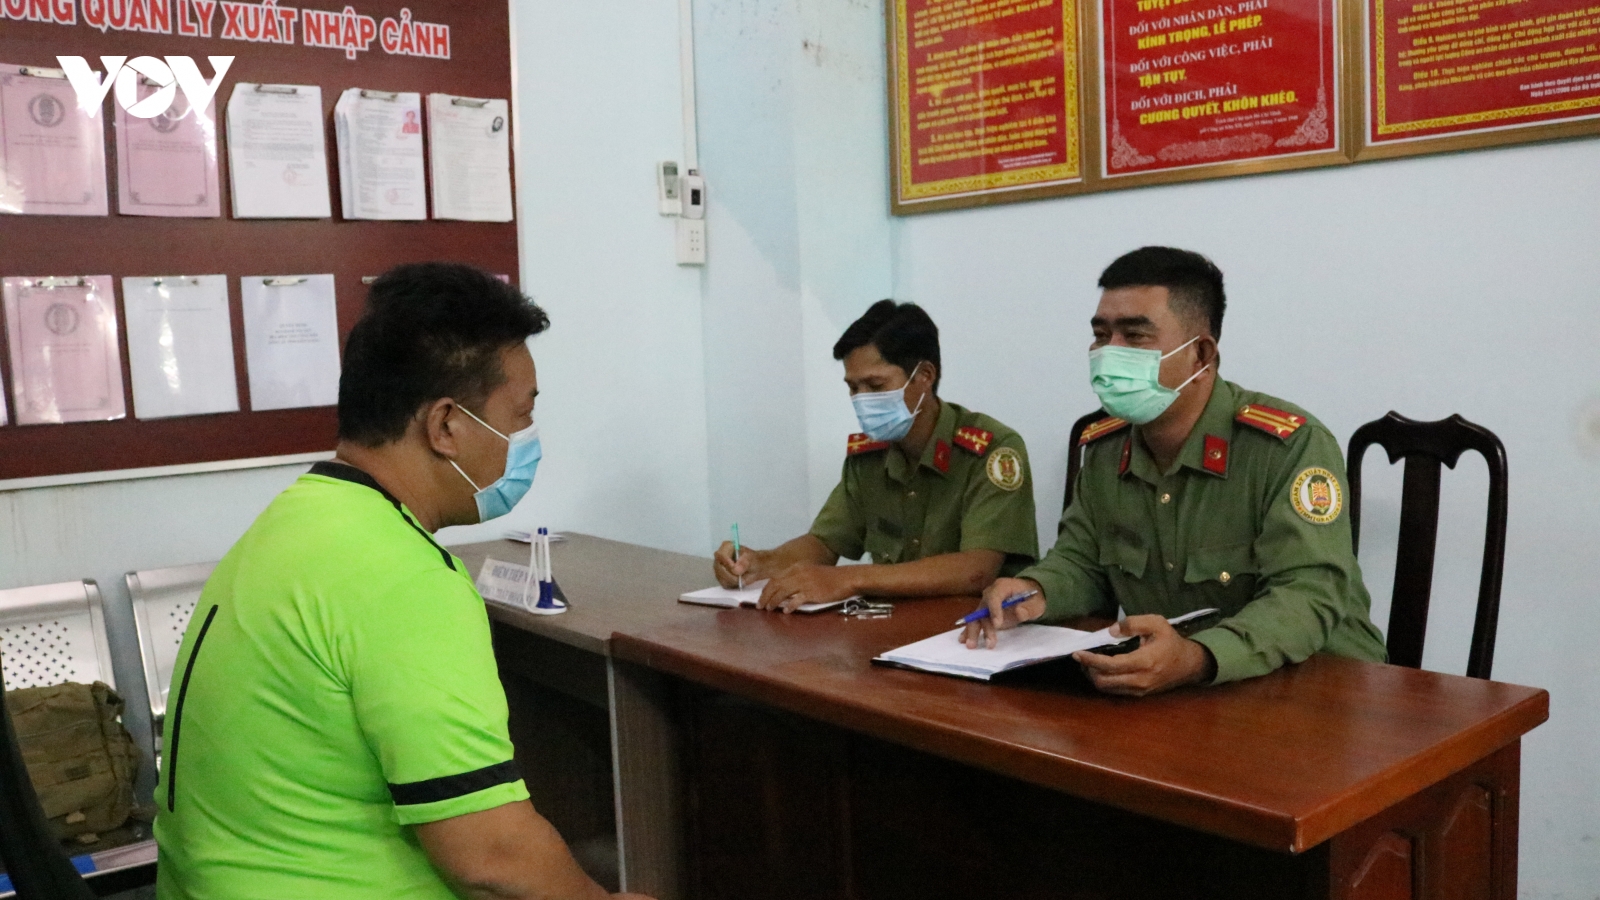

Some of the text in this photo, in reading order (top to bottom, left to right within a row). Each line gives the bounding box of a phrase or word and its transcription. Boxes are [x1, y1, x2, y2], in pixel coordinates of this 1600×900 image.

[221, 0, 298, 44] XUẤT
[302, 6, 376, 60] NHẬP
[379, 7, 450, 59] CẢNH
[1129, 20, 1149, 36] ĐỐI
[1151, 16, 1171, 30] VỚI
[1172, 10, 1205, 27] NHÂN
[1207, 4, 1236, 19] DÂN,
[1137, 34, 1166, 50] KÍNH
[1229, 14, 1263, 32] PHÉP.
[1129, 35, 1273, 73] ĐỐI VỚI CÔNG VIỆC, PHẢI
[1130, 95, 1151, 111] ĐỐI
[1152, 92, 1172, 107] VỚI
[1208, 82, 1238, 99] PHẢI
[1138, 73, 1161, 88] TẬN
[1139, 107, 1180, 125] CƯƠNG
[1222, 95, 1258, 113] KHÔN
[1260, 90, 1299, 107] KHÉO.
